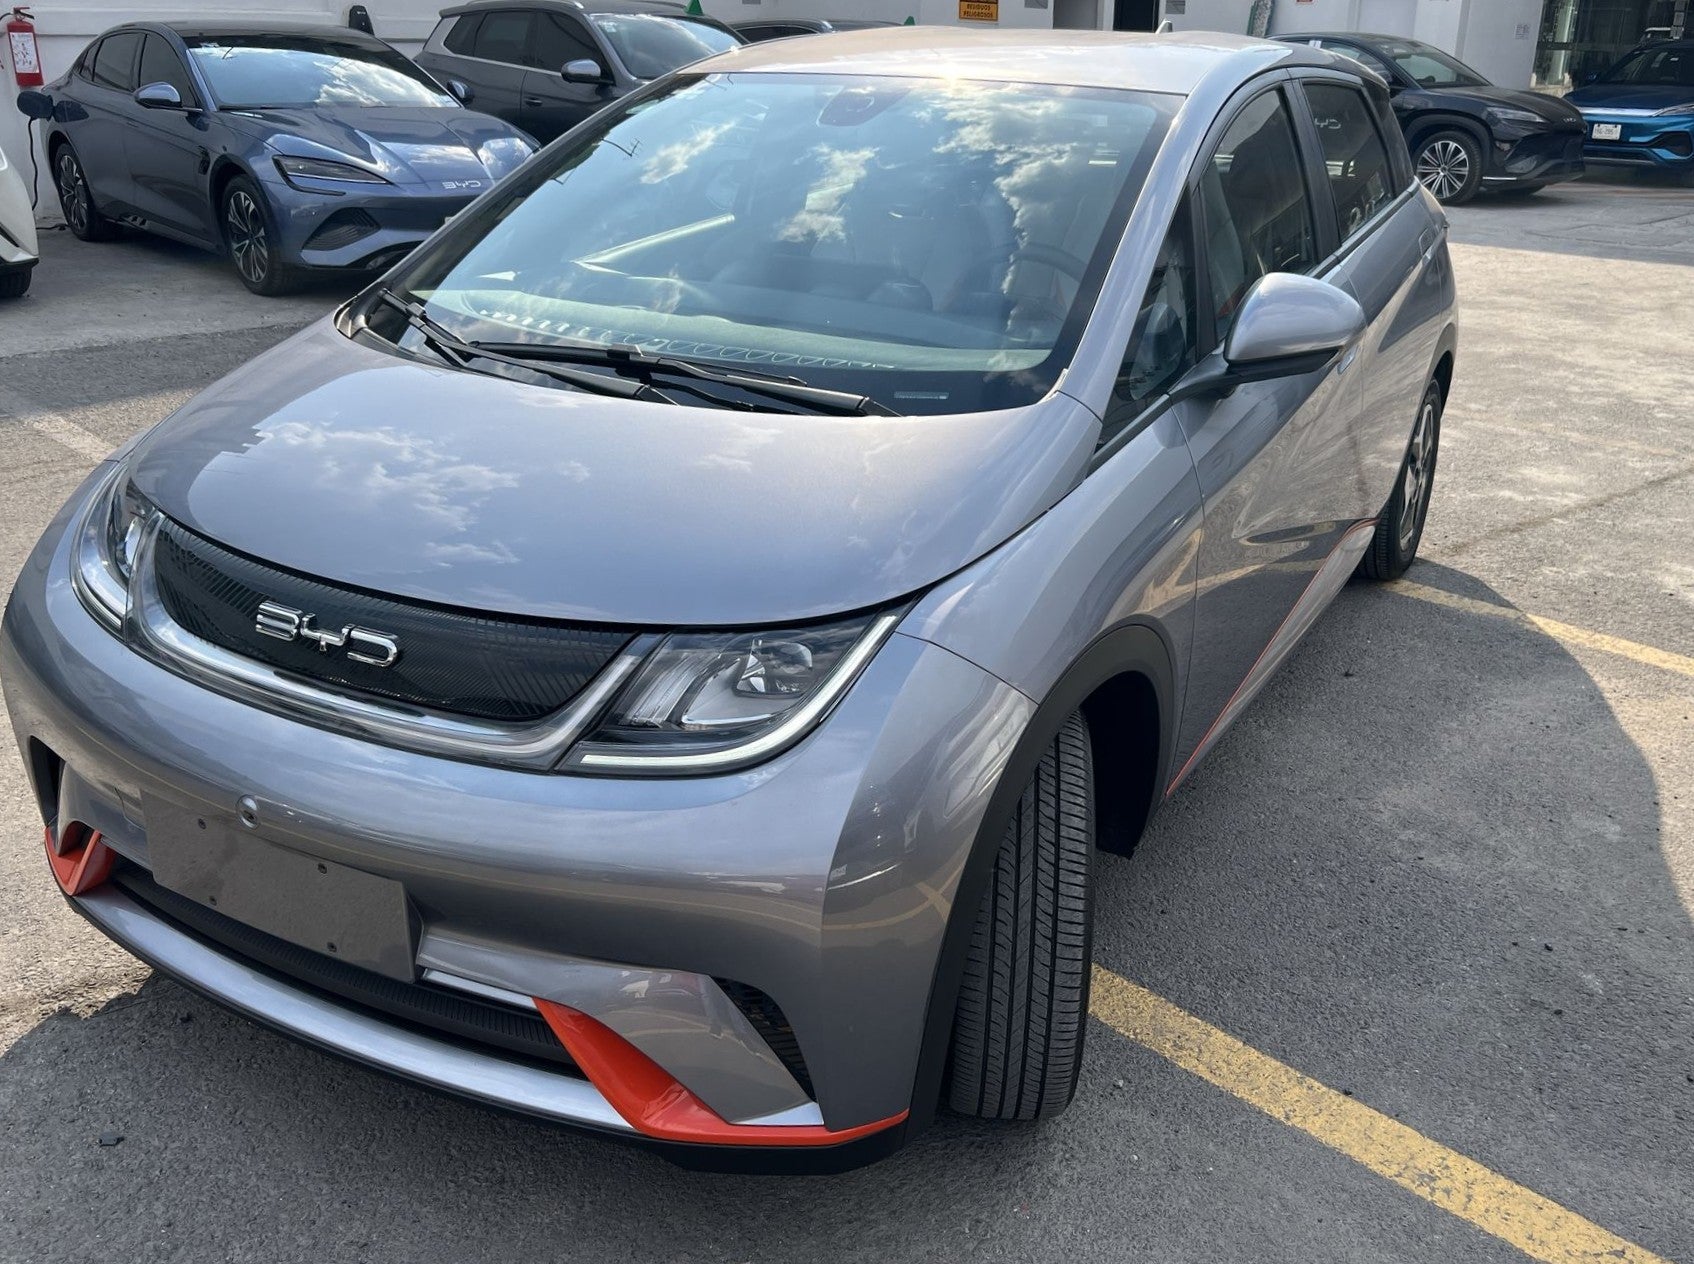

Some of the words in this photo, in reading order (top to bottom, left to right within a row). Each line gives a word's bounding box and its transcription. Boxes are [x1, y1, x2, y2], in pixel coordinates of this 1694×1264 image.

[963, 10, 993, 18] PELIGROSOS
[441, 180, 481, 189] BYD
[255, 600, 398, 667] BYD
